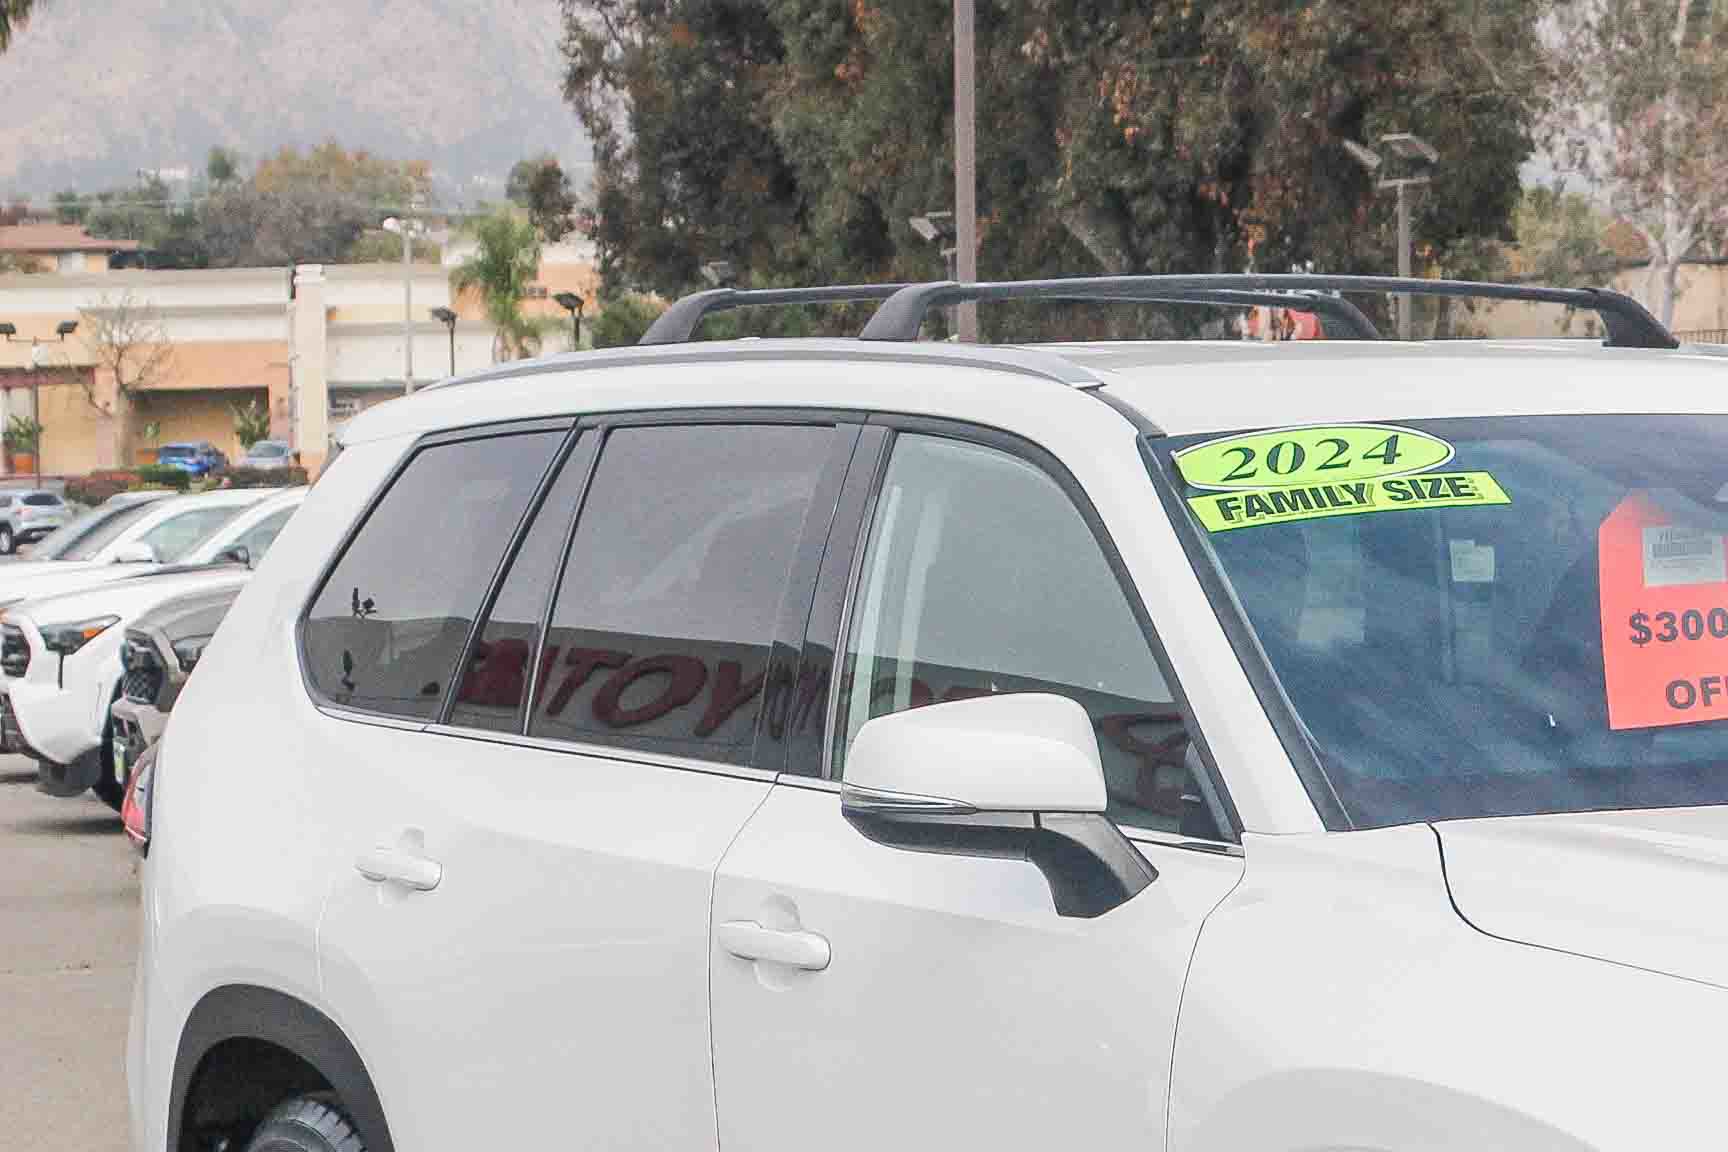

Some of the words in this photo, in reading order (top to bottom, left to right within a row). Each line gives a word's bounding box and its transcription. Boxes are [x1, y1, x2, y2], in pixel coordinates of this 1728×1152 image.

[1220, 434, 1402, 482] 2024
[1215, 482, 1370, 522] FAMILY
[1382, 476, 1477, 502] SIZE
